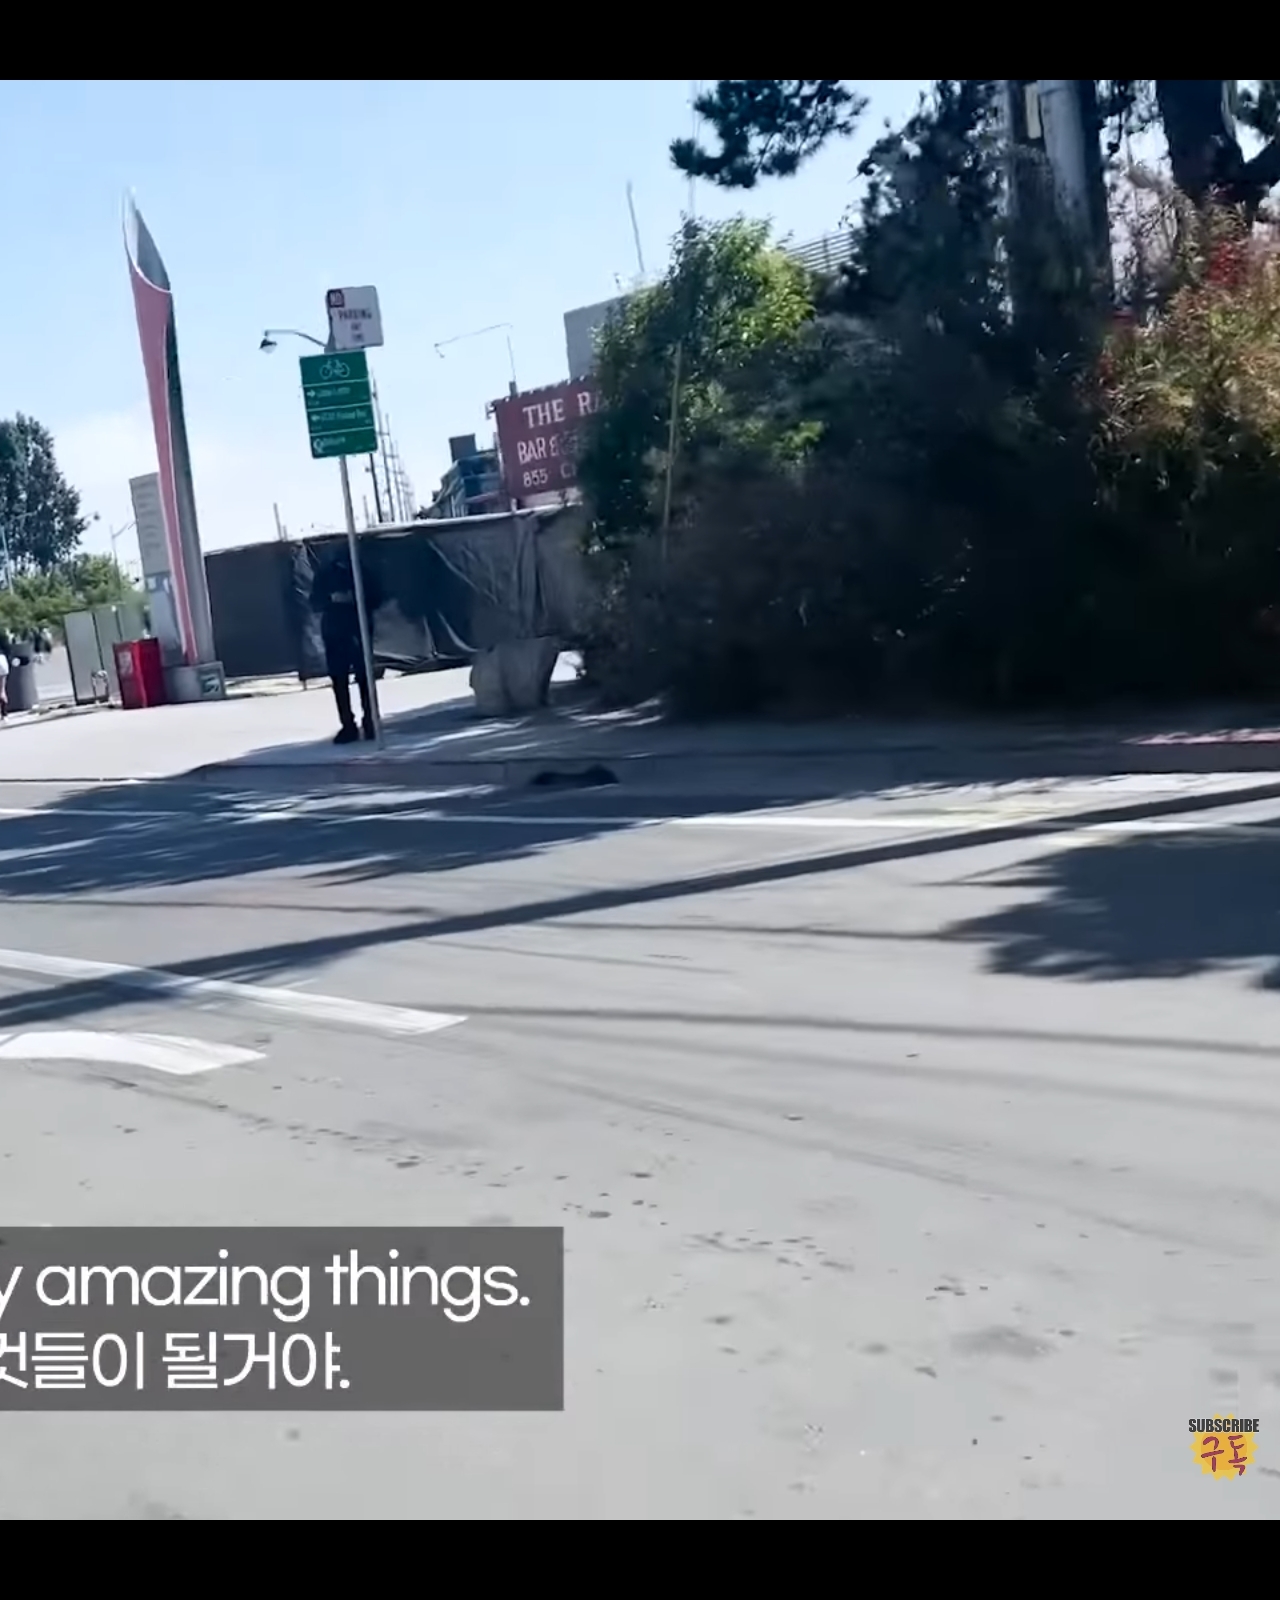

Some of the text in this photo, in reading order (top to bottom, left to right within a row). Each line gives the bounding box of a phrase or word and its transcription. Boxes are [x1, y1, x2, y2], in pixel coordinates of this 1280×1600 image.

[522, 398, 565, 429] THE
[517, 437, 547, 464] BAR
[523, 468, 548, 488] 855
